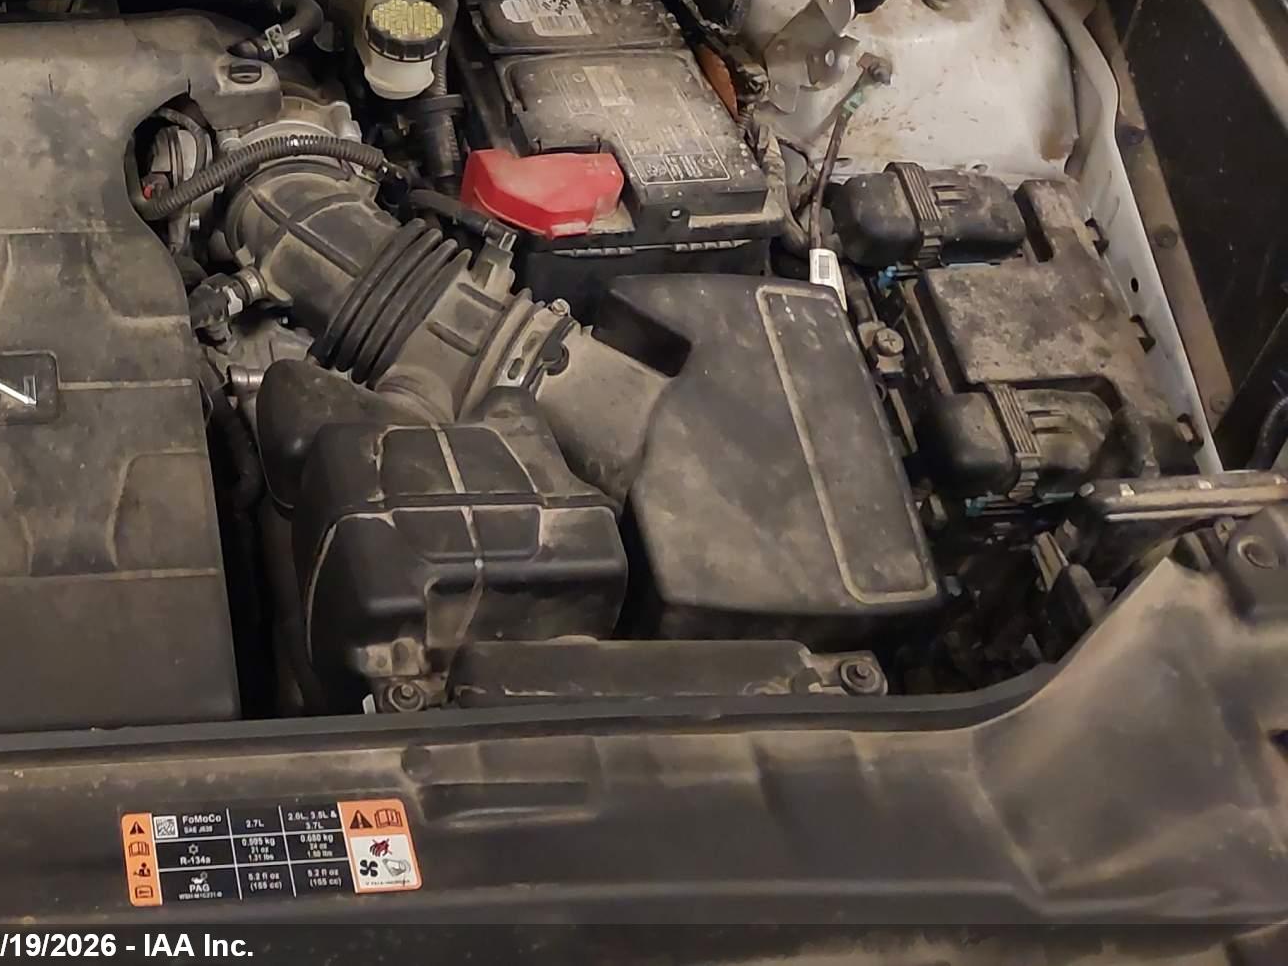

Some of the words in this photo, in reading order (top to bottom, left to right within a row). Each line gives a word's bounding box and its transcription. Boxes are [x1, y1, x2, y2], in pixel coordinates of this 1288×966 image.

[182, 813, 222, 825] FoMoCo
[245, 819, 265, 829] 2.7L
[305, 821, 324, 830] 3.7L
[264, 837, 276, 847] kg
[323, 834, 334, 843] kg
[180, 855, 211, 866] R-134a
[269, 872, 280, 880] oz
[329, 868, 339, 876] oz
[269, 881, 282, 891] cc)
[328, 877, 342, 887] cc)
[189, 883, 211, 893] PAG
